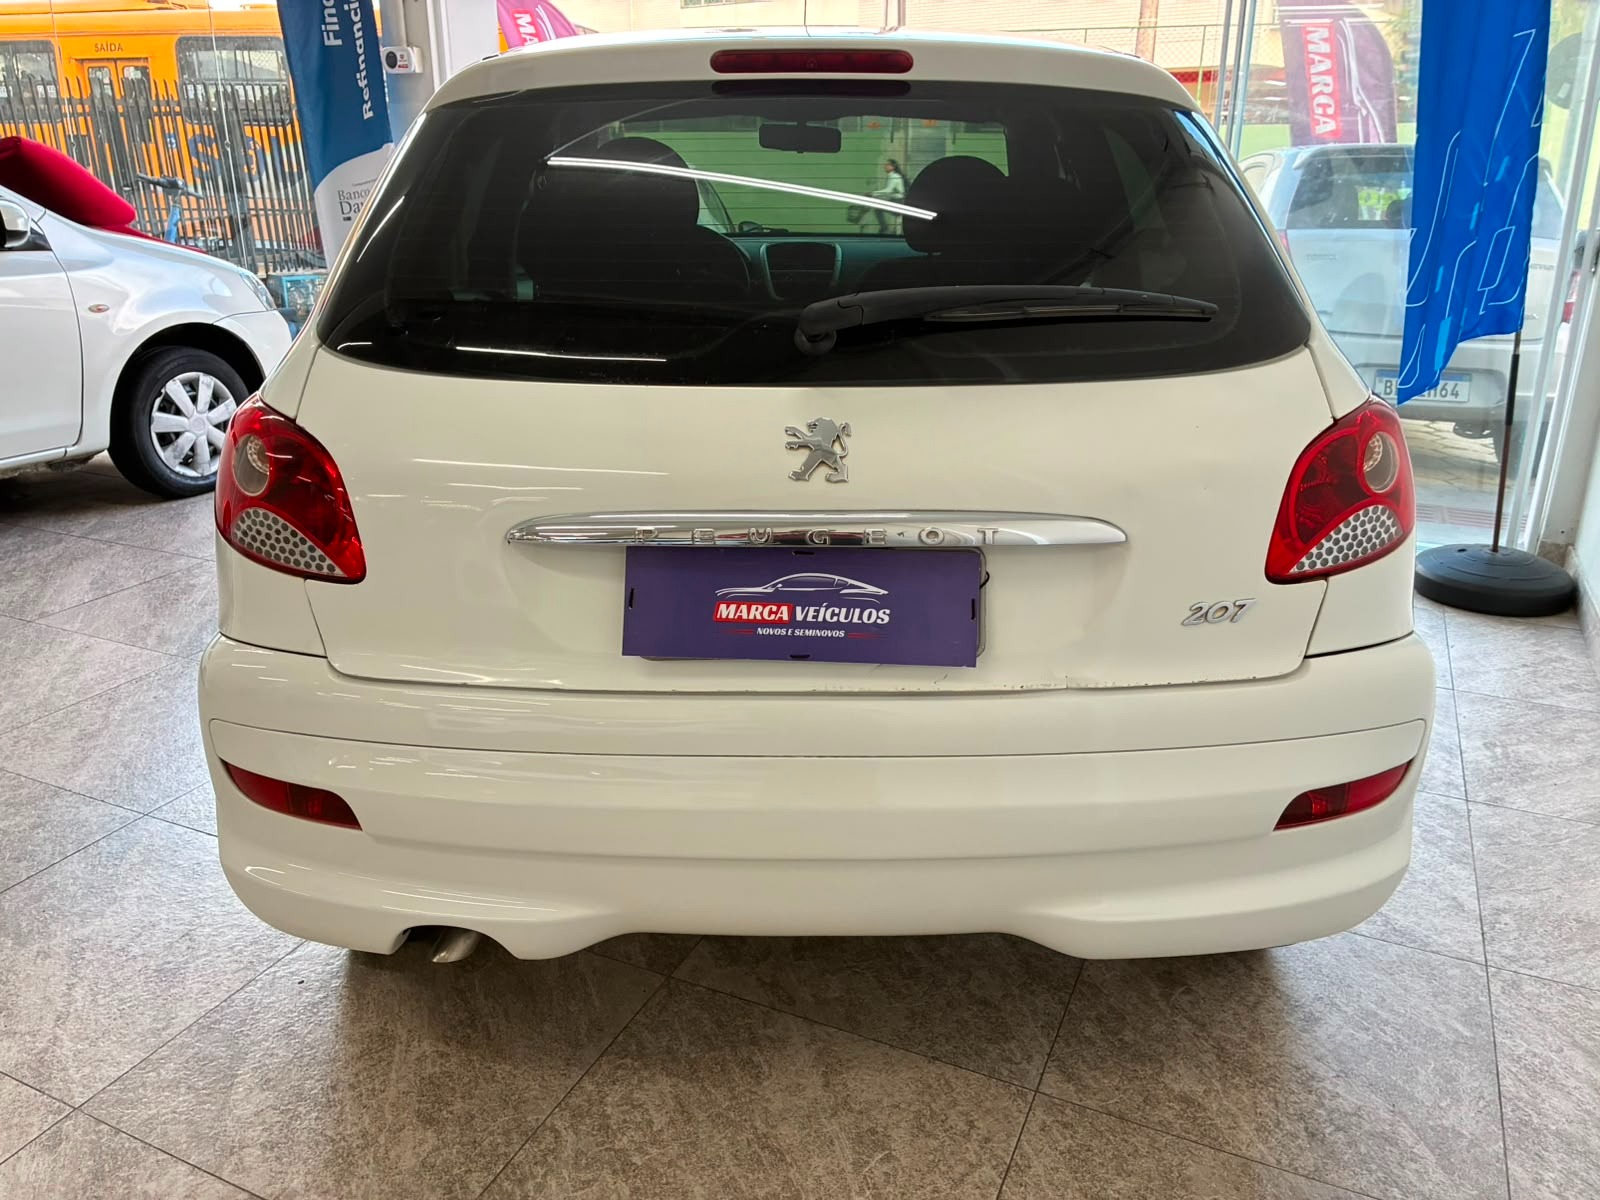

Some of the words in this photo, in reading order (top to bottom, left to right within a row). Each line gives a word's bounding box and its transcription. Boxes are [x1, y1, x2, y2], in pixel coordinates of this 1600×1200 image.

[94, 41, 124, 53] SAÍDA
[343, 0, 374, 120] Refinanci
[1305, 27, 1337, 134] MARCA
[337, 187, 371, 201] Banco
[633, 526, 1000, 546] PEUGEOT
[716, 603, 790, 621] MARCA
[794, 602, 891, 625] VEÍCULOS
[1180, 597, 1257, 627] 207
[756, 627, 788, 637] NOVOS
[787, 628, 795, 637] E
[794, 628, 846, 639] SEMINOVOS
